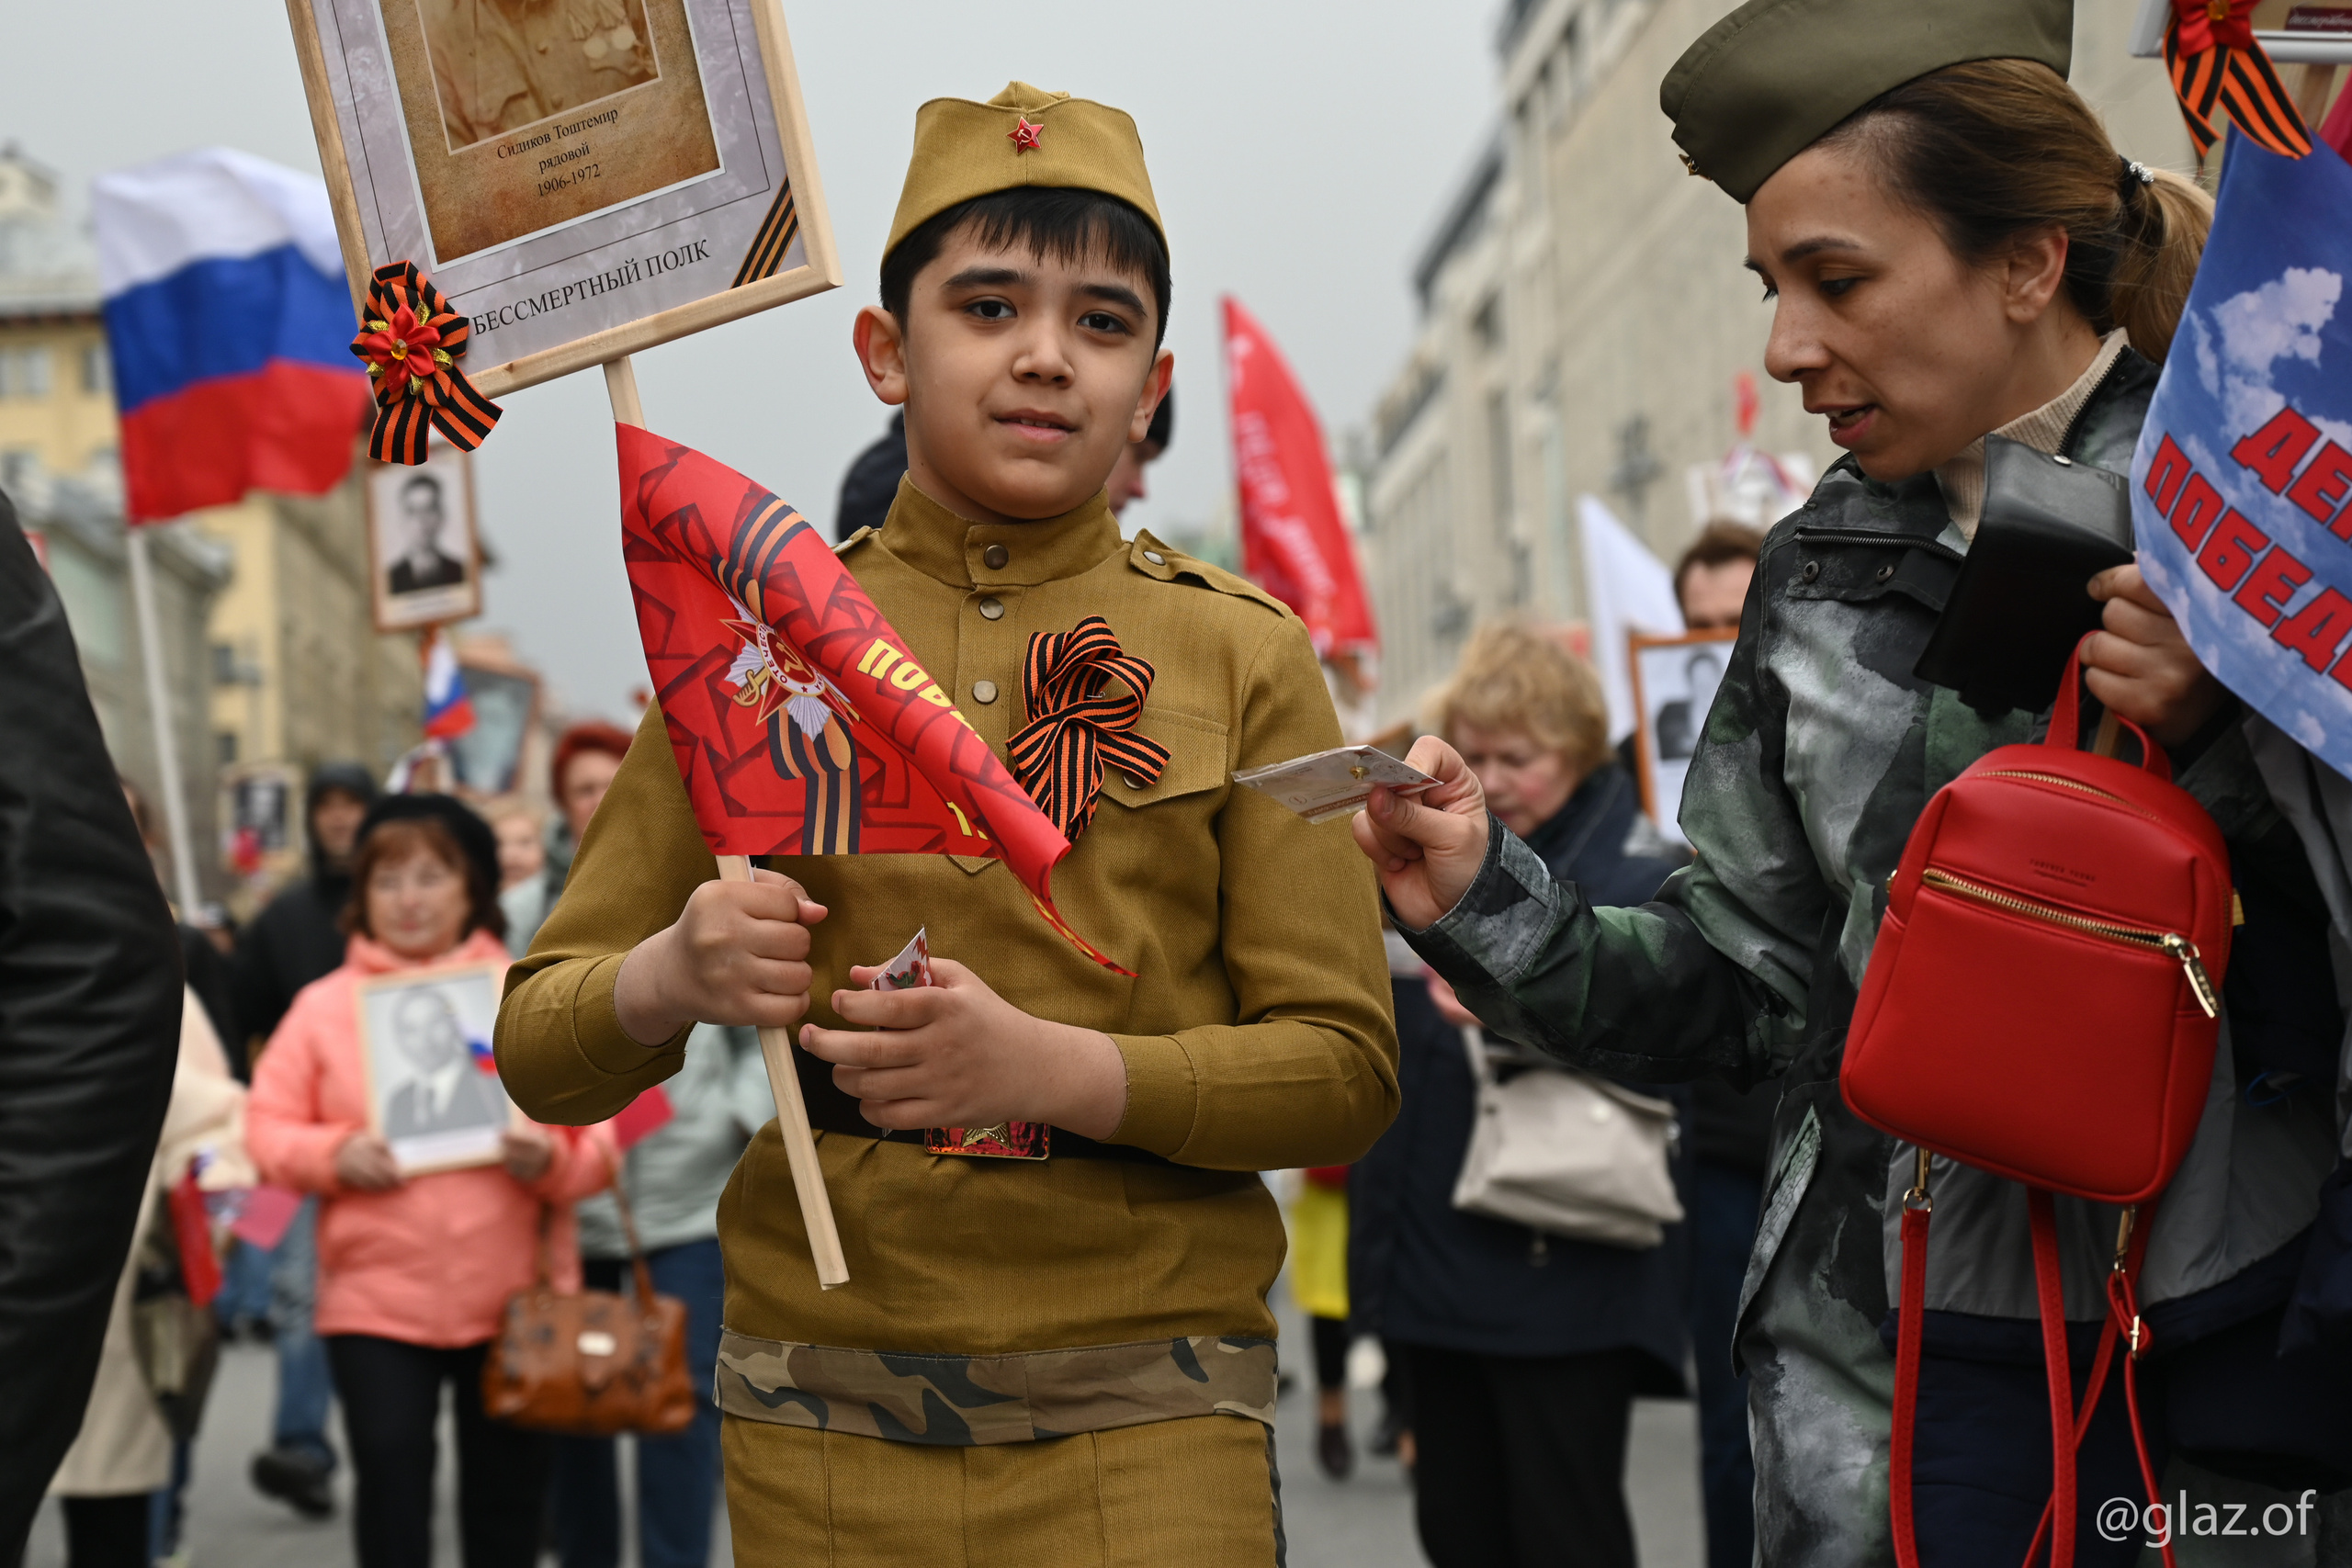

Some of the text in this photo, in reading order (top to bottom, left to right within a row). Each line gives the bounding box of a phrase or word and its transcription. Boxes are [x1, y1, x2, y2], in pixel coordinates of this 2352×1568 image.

[497, 108, 618, 159] Сидиков Тоштемир
[538, 142, 591, 175] рядовой
[537, 164, 601, 197] 1906-1972
[472, 239, 710, 335] БЕССМЕРТНЫЙ ПОЛК
[2143, 431, 2352, 694] ПОБЕД
